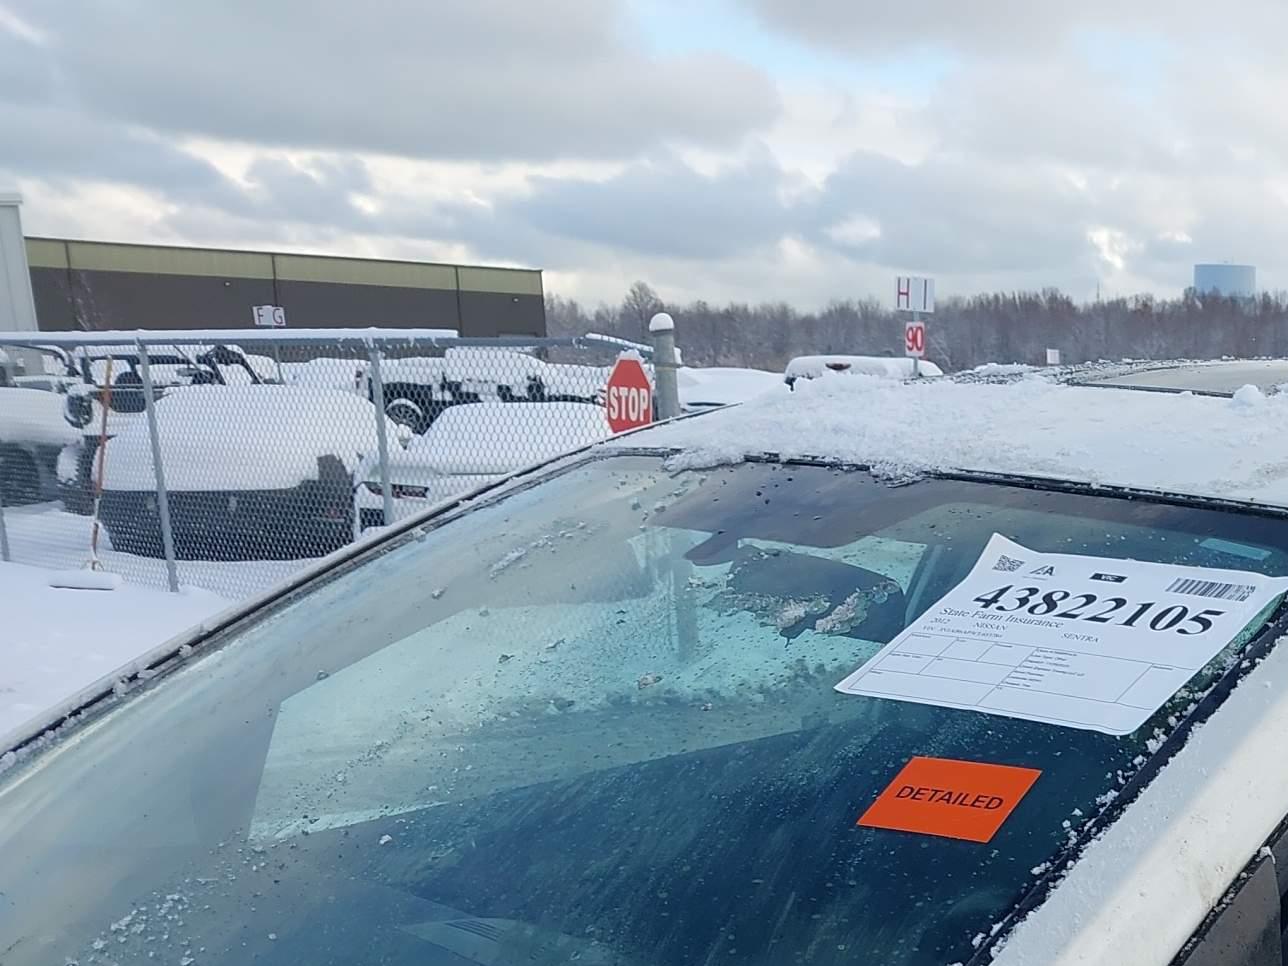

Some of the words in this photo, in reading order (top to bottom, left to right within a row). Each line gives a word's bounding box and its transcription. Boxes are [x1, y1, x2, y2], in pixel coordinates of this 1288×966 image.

[897, 277, 909, 309] H
[257, 308, 264, 323] F
[273, 308, 283, 323] G
[906, 326, 924, 352] 90
[609, 386, 649, 422] STOP
[939, 607, 971, 618] State
[971, 609, 1004, 622] Farm
[1004, 613, 1065, 630] Insurance
[973, 584, 1226, 636] 43822105
[973, 622, 1009, 632] NISSAN
[1061, 632, 1100, 643] SENTRA
[896, 785, 1004, 810] DETAILED
